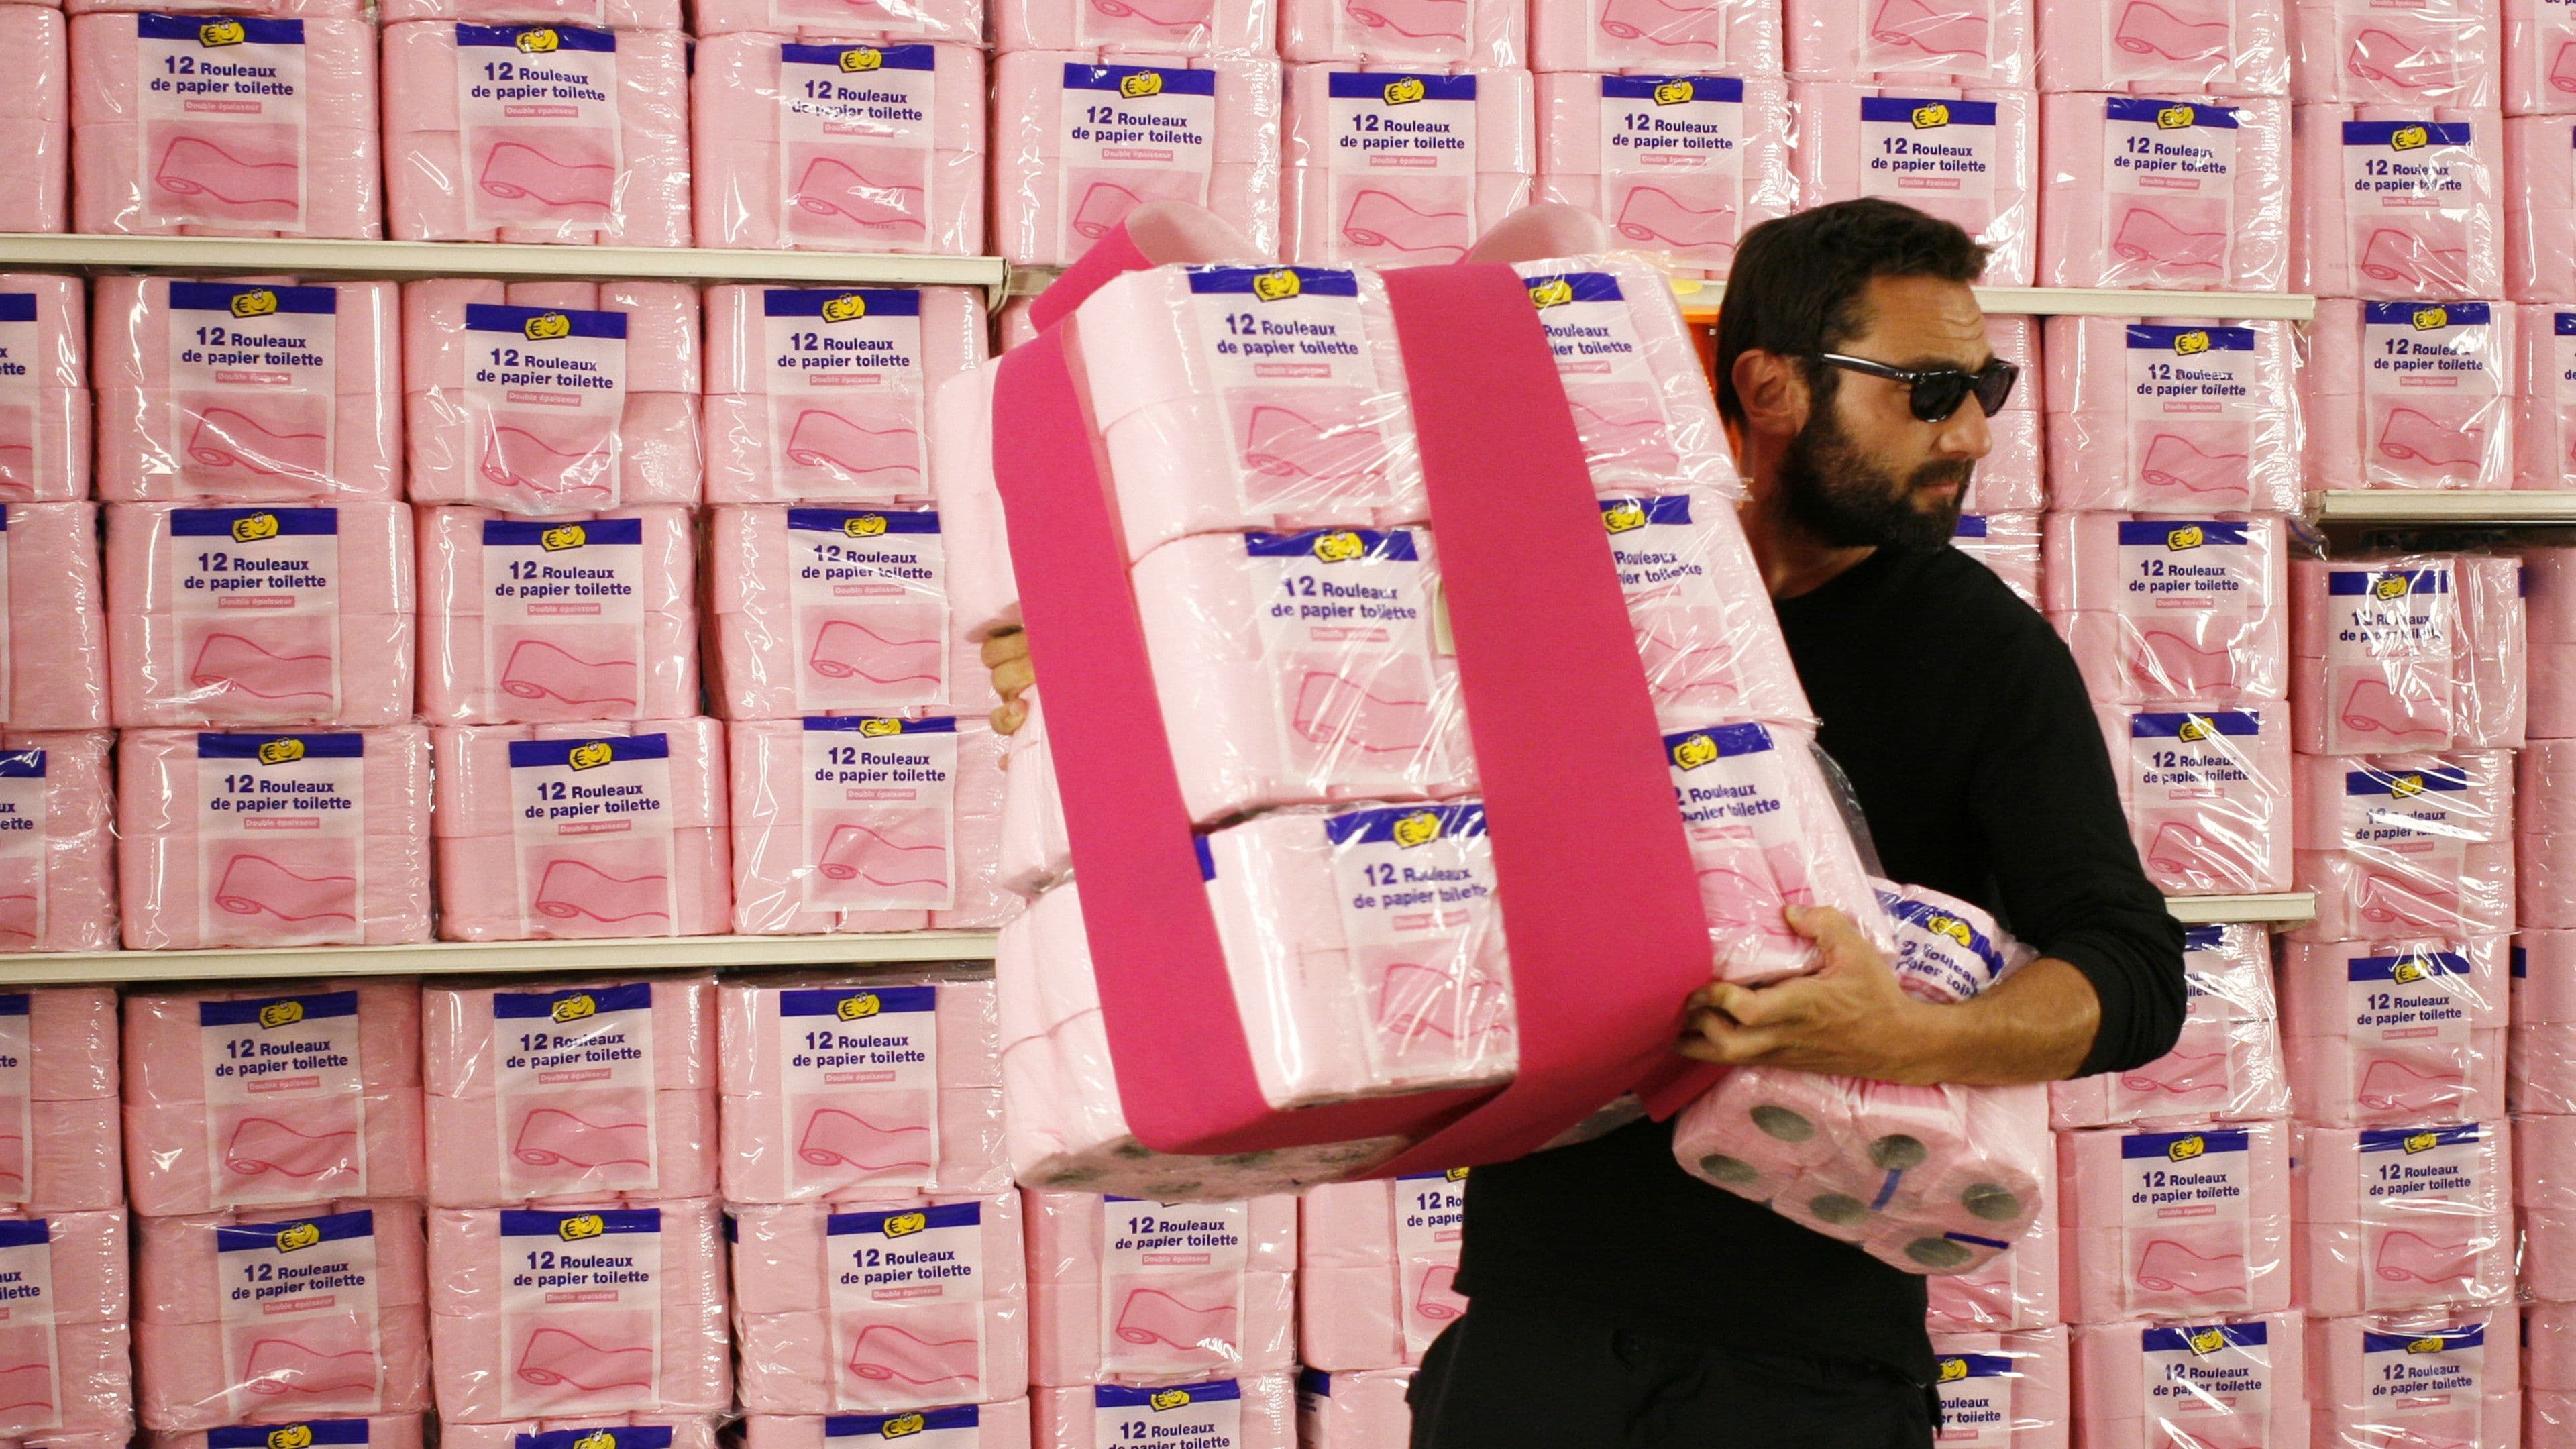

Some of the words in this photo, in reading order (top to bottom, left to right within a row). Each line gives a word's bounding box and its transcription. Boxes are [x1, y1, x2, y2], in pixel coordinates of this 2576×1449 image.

[165, 56, 195, 75] 12
[201, 63, 277, 78] Rouleaux
[484, 62, 514, 81] 12
[519, 68, 588, 85] Rouleaux
[151, 78, 171, 91] de
[176, 79, 229, 95] papier
[235, 81, 294, 96] toilette
[472, 85, 491, 98] de
[496, 85, 548, 101] papier
[553, 86, 606, 101] toilette
[186, 101, 215, 110] Double
[1087, 106, 1113, 125] 12
[1118, 113, 1187, 127] Rouleaux
[1353, 114, 1379, 131] 12
[1385, 120, 1450, 133] Rouleaux
[1625, 113, 1650, 131] 12
[1655, 119, 1718, 133] Rouleaux
[1072, 127, 1090, 140] de
[1095, 129, 1144, 144] papier
[1149, 130, 1203, 145] toilette
[1340, 136, 1358, 148] de
[1363, 136, 1410, 150] papier
[1414, 137, 1465, 149] toilette
[1613, 133, 1629, 146] de
[1635, 136, 1679, 150] papier
[1683, 137, 1733, 149] toilette
[1884, 138, 1908, 154] 12
[1913, 144, 1972, 156] Rouleaux
[1872, 158, 1888, 169] de
[1893, 159, 1936, 172] papier
[1939, 160, 1986, 172] toilette
[1226, 313, 1257, 335] 12
[1262, 321, 1336, 336] Rouleaux
[197, 327, 226, 346] 12
[231, 333, 307, 349] Rouleaux
[791, 333, 818, 351] 12
[824, 338, 894, 351] Rouleaux
[182, 349, 203, 363] de
[208, 351, 260, 366] papier
[264, 352, 323, 366] toilette
[1218, 340, 1238, 354] de
[1243, 340, 1295, 357] papier
[1299, 341, 1358, 355] toilette
[1578, 341, 1633, 356] toilette
[491, 348, 519, 367] 12
[525, 356, 597, 372] Rouleaux
[778, 355, 796, 368] de
[802, 355, 851, 370] papier
[856, 354, 910, 367] toilette
[477, 369, 496, 382] de
[501, 372, 552, 386] papier
[557, 374, 614, 389] toilette
[199, 553, 228, 572] 12
[234, 558, 309, 572] Rouleaux
[510, 561, 538, 580] 12
[542, 566, 614, 579] Rouleaux
[2141, 560, 2164, 576] 12
[2169, 565, 2226, 576] Rouleaux
[184, 576, 205, 590] de
[210, 576, 264, 592] papier
[268, 575, 327, 588] toilette
[496, 584, 515, 596] de
[521, 583, 570, 599] papier
[575, 583, 632, 596] toilette
[1285, 575, 1316, 596] 12
[2129, 580, 2146, 592] de
[2150, 580, 2192, 594] papier
[2195, 580, 2239, 591] toilette
[1271, 604, 1293, 616] de
[1301, 602, 1354, 620] papier
[828, 747, 856, 765] 12
[861, 753, 930, 765] Rouleaux
[225, 775, 254, 794] 12
[260, 780, 335, 793] Rouleaux
[816, 769, 834, 781] de
[840, 769, 888, 784] papier
[893, 769, 946, 782] toilette
[537, 782, 567, 801] 12
[572, 785, 643, 799] Rouleaux
[211, 798, 231, 810] de
[237, 797, 288, 813] papier
[293, 797, 352, 810] toilette
[525, 806, 545, 818] de
[550, 803, 600, 820] papier
[605, 798, 660, 814] toilette
[2368, 994, 2390, 1010] 12
[2394, 996, 2450, 1008] Rouleaux
[2357, 1014, 2373, 1026] de
[2377, 1012, 2416, 1026] papier
[2419, 1008, 2462, 1021] toilette
[227, 1039, 255, 1059] 12
[260, 1041, 331, 1057] Rouleaux
[806, 1032, 833, 1050] 12
[839, 1035, 909, 1049] Rouleaux
[216, 1064, 234, 1077] de
[239, 1060, 288, 1077] papier
[292, 1055, 348, 1070] toilette
[793, 1055, 812, 1067] de
[817, 1053, 866, 1069] papier
[871, 1051, 925, 1064] toilette
[2143, 1171, 2166, 1188] 12
[2170, 1174, 2227, 1186] Rouleaux
[2379, 1164, 2401, 1181] 12
[2405, 1166, 2459, 1179] Rouleaux
[2132, 1192, 2147, 1203] de
[2152, 1189, 2193, 1205] papier
[2196, 1186, 2240, 1199] toilette
[2370, 1185, 2384, 1196] de
[2388, 1181, 2426, 1197] papier
[2429, 1177, 2471, 1190] toilette
[1129, 1217, 1155, 1234] 12
[1159, 1220, 1225, 1233] Rouleaux
[1116, 1238, 1132, 1250] de
[1137, 1236, 1183, 1250] papier
[1187, 1234, 1238, 1246] toilette
[527, 1251, 555, 1270] 12
[561, 1256, 633, 1269] Rouleaux
[853, 1249, 881, 1268] 12
[885, 1251, 955, 1266] Rouleaux
[244, 1263, 273, 1283] 12
[278, 1263, 349, 1280] Rouleaux
[514, 1274, 533, 1287] de
[538, 1273, 588, 1288] papier
[593, 1271, 649, 1284] toilette
[841, 1273, 859, 1285] de
[865, 1269, 913, 1285] papier
[918, 1265, 971, 1279] toilette
[232, 1287, 251, 1301] de
[256, 1282, 305, 1301] papier
[309, 1274, 366, 1291] toilette
[2383, 1364, 2405, 1381] 12
[2408, 1365, 2461, 1379] Rouleaux
[2373, 1385, 2387, 1396] de
[2391, 1381, 2429, 1397] papier
[2432, 1377, 2473, 1390] toilette
